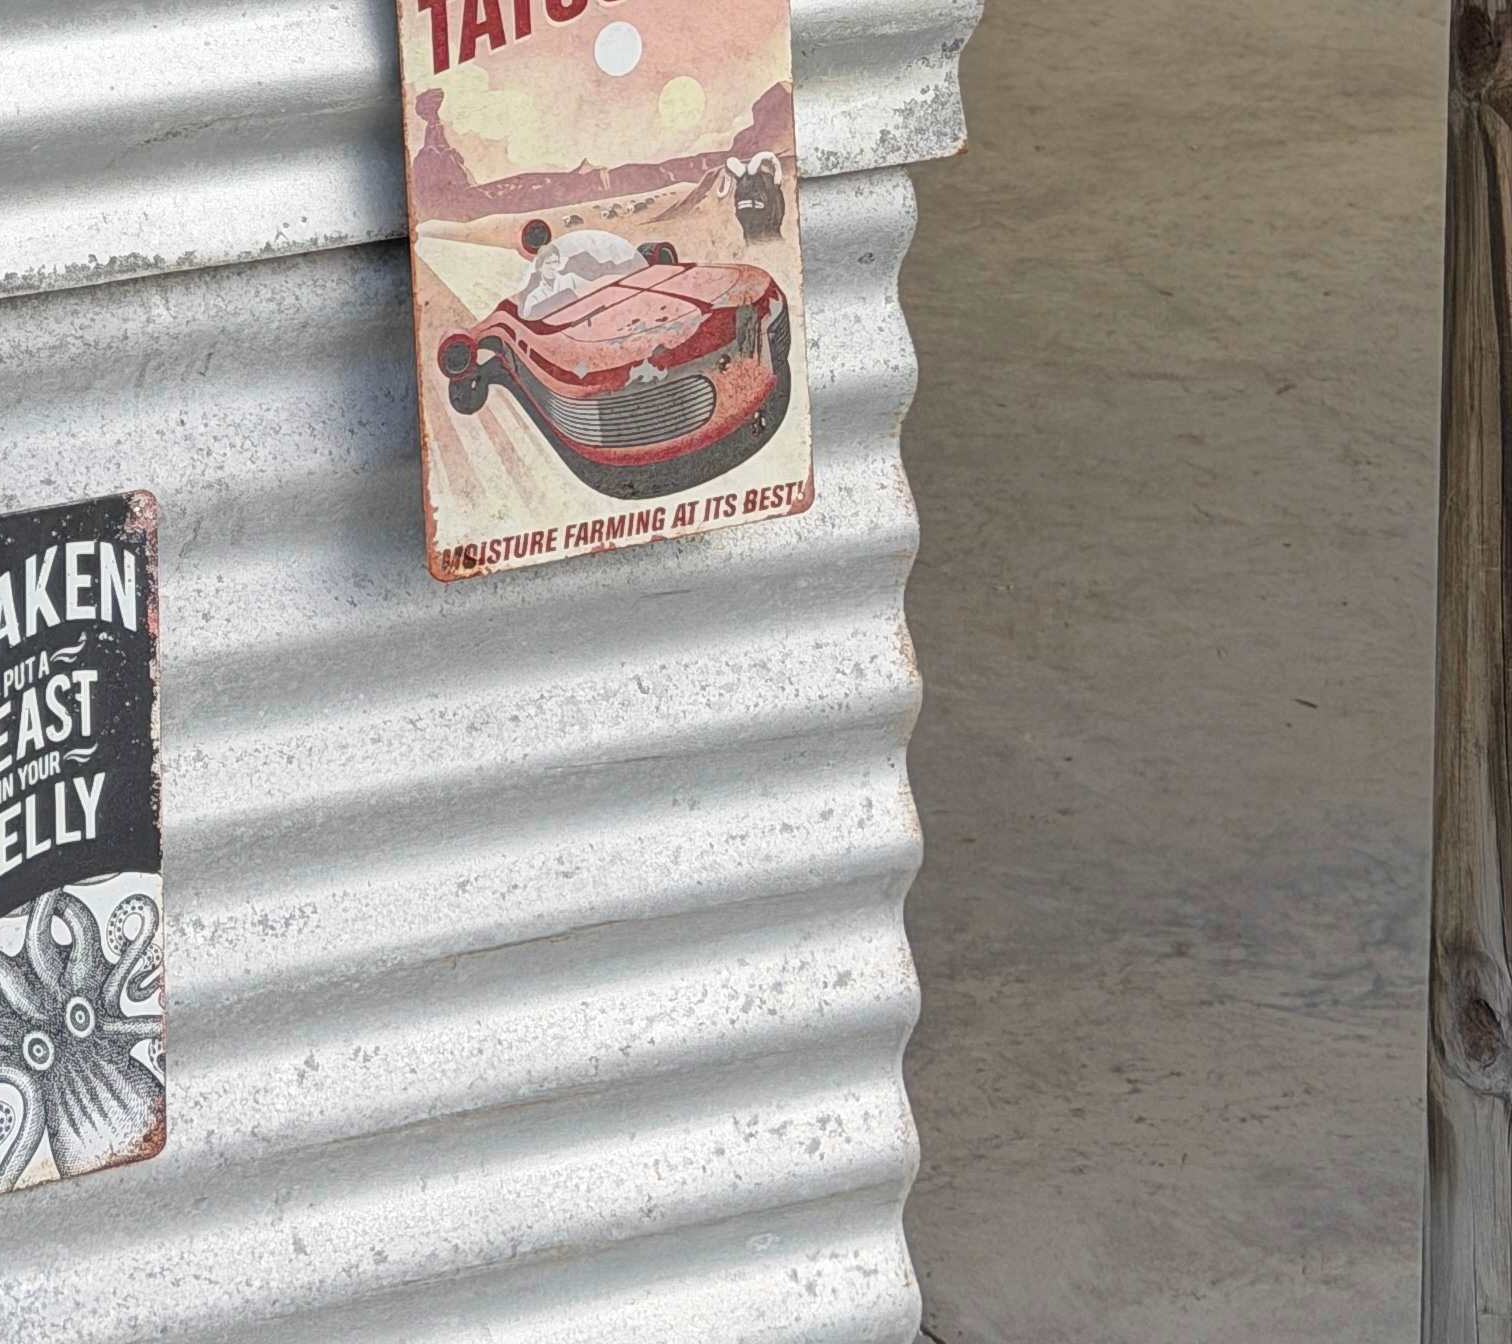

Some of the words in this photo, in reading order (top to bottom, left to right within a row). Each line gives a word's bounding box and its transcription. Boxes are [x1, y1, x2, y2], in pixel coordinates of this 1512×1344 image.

[563, 504, 665, 551] FARMING
[672, 500, 699, 528] AT
[704, 492, 737, 523] ITS
[3, 657, 35, 699] PUT
[37, 650, 50, 686] A
[17, 751, 61, 793] YOUR
